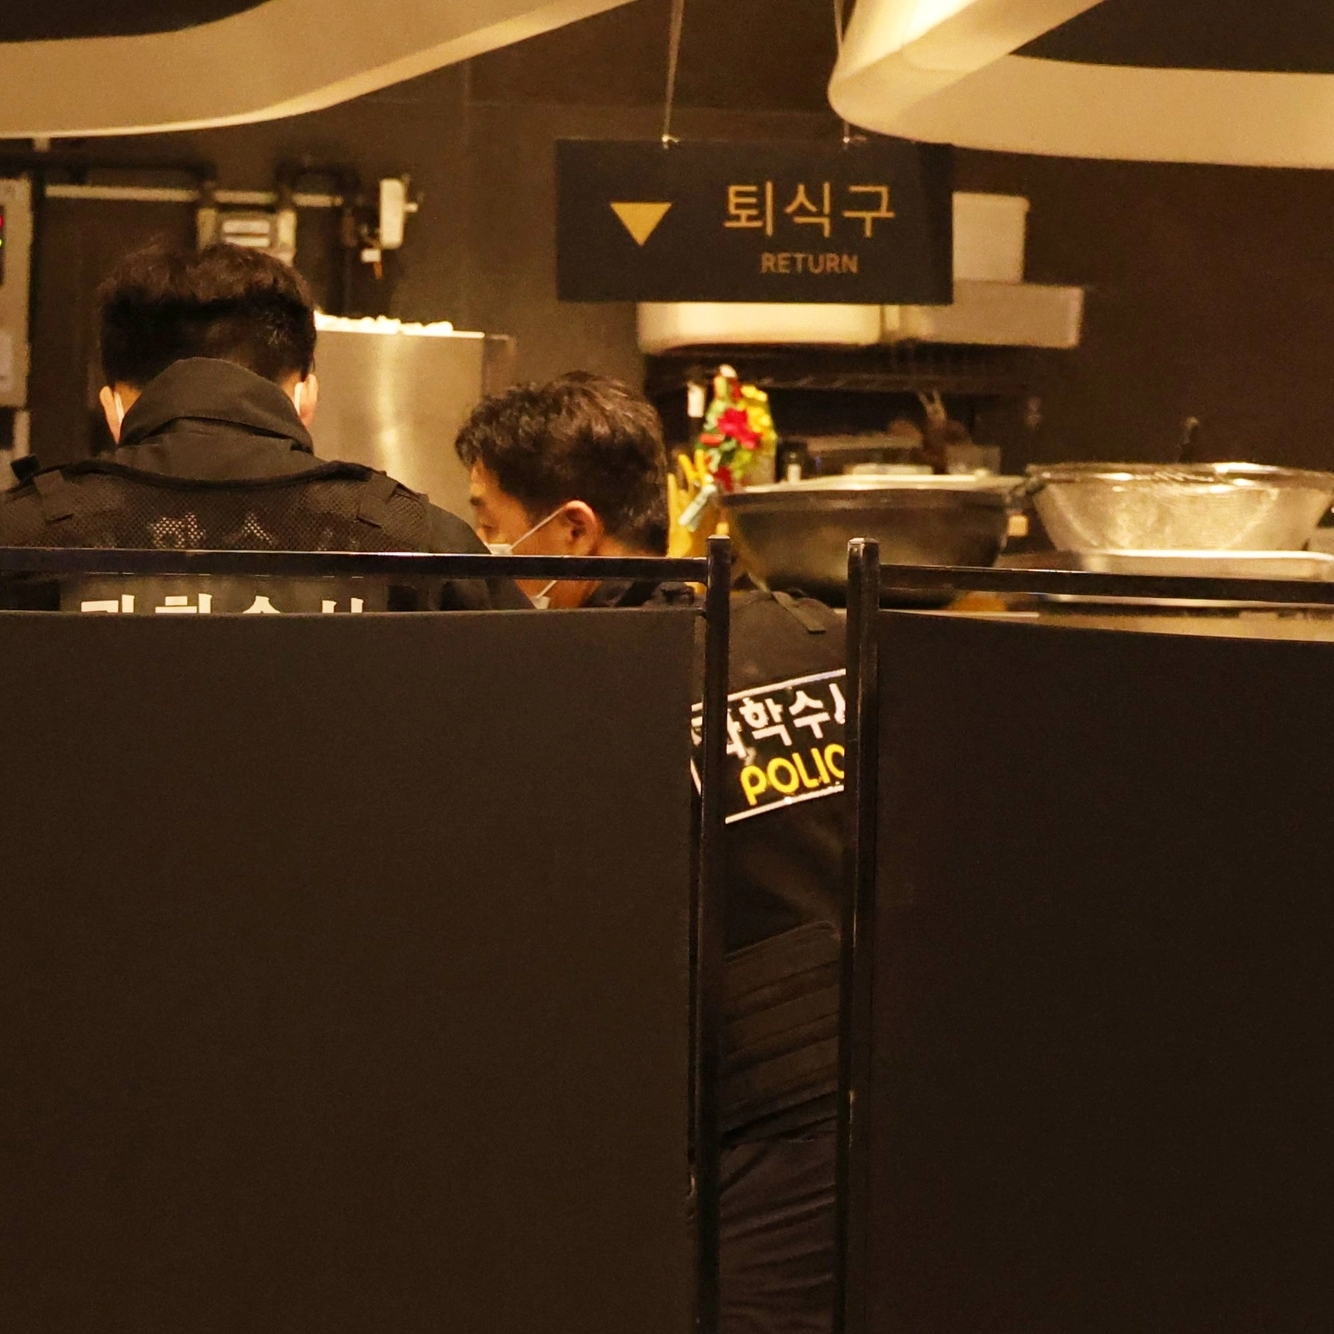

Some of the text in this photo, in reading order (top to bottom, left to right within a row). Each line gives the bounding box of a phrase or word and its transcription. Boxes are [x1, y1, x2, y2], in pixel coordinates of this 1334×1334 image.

[723, 181, 895, 238] 퇴식구
[760, 252, 859, 274] RETURN
[740, 743, 845, 806] POLIC
